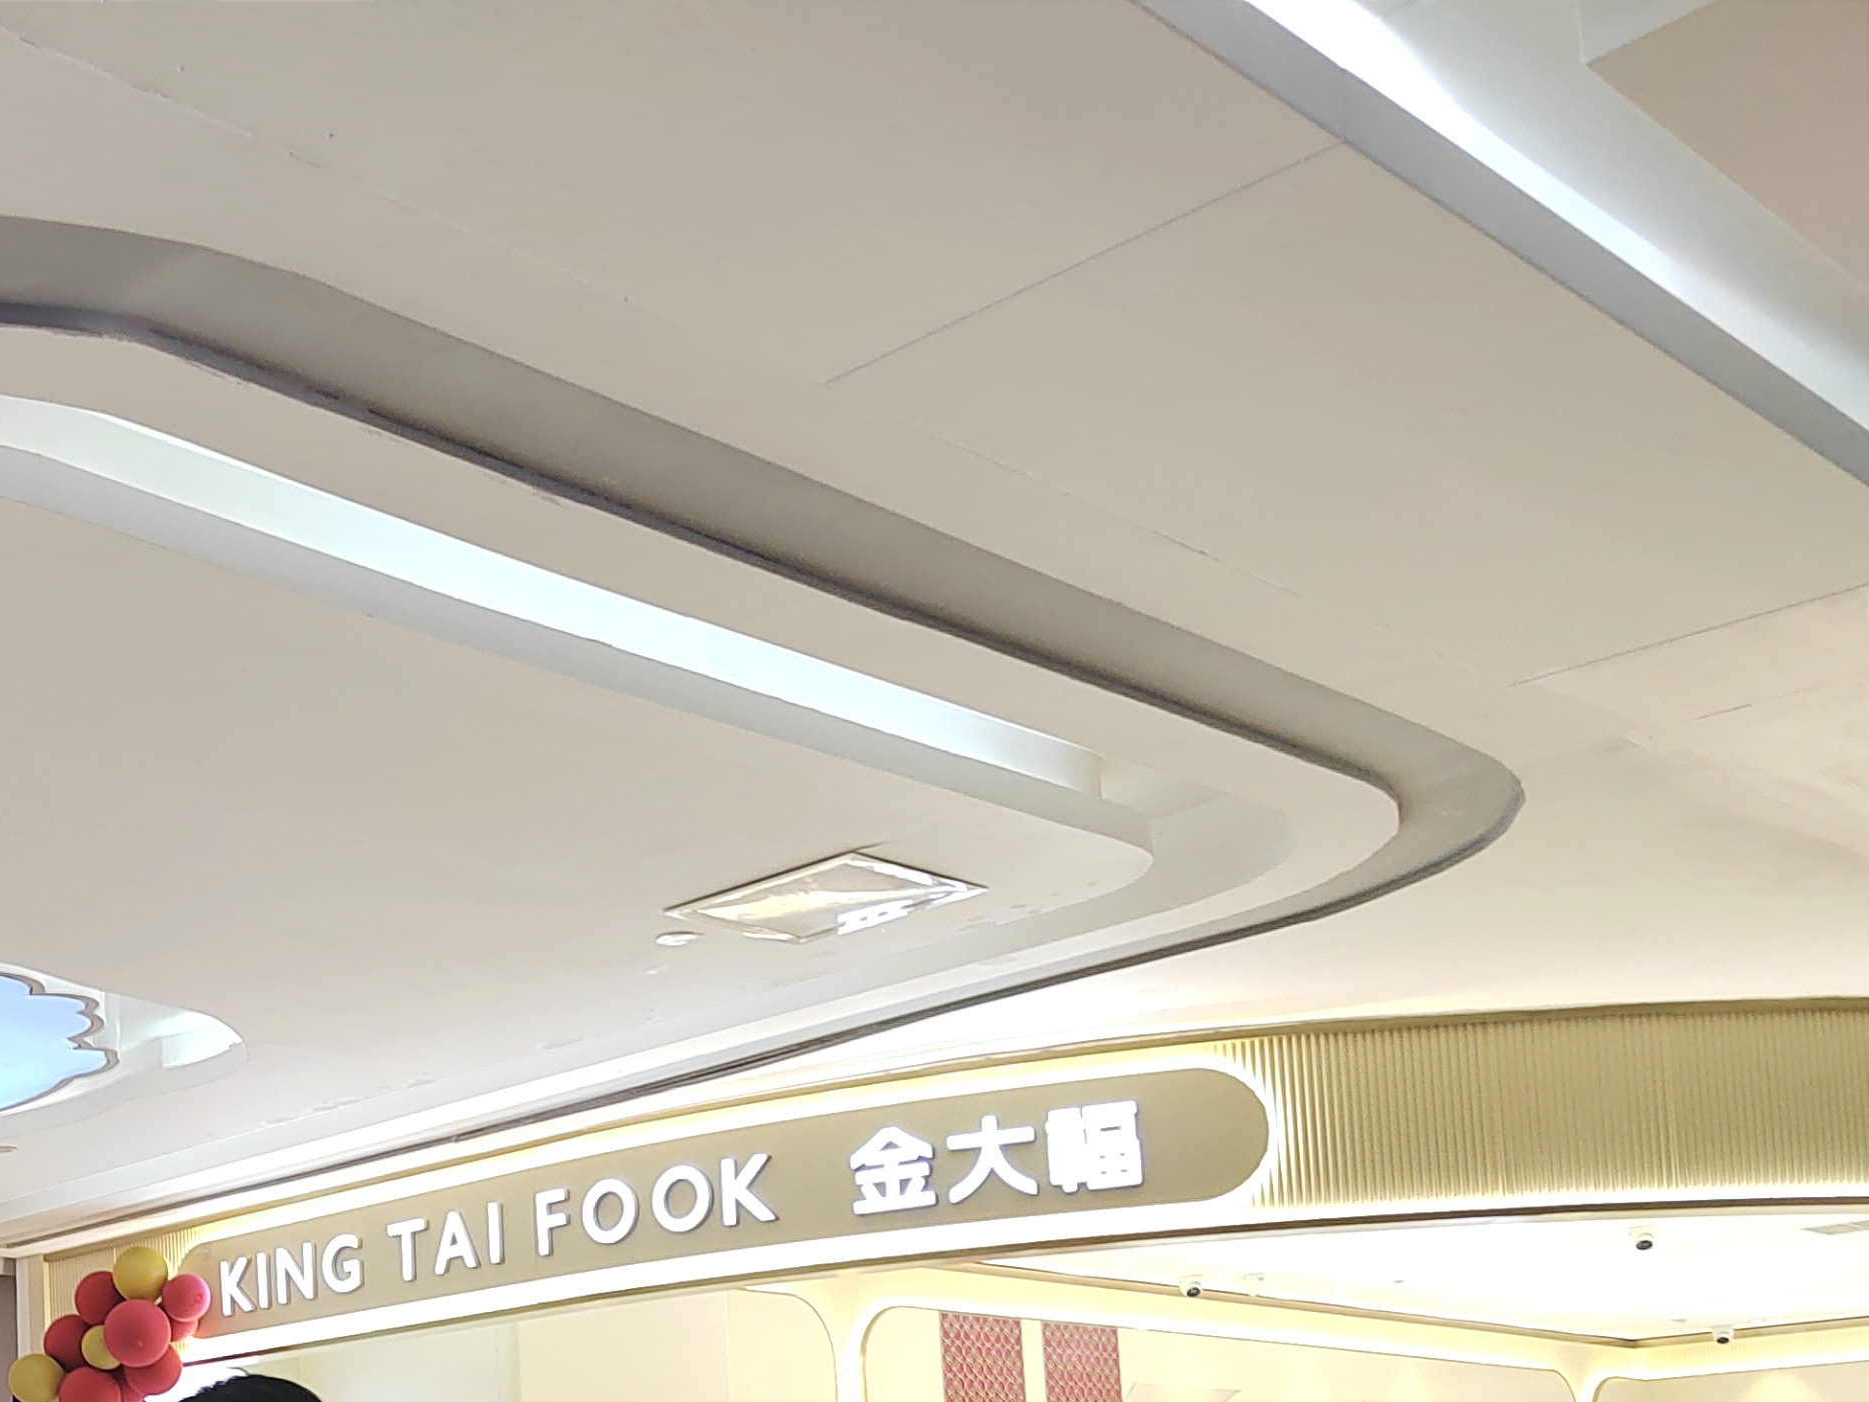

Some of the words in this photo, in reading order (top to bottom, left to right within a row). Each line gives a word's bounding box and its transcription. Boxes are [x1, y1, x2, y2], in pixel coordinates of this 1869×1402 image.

[219, 1234, 363, 1317] KING
[386, 1201, 505, 1283] TAI
[535, 1153, 779, 1257] FOOK
